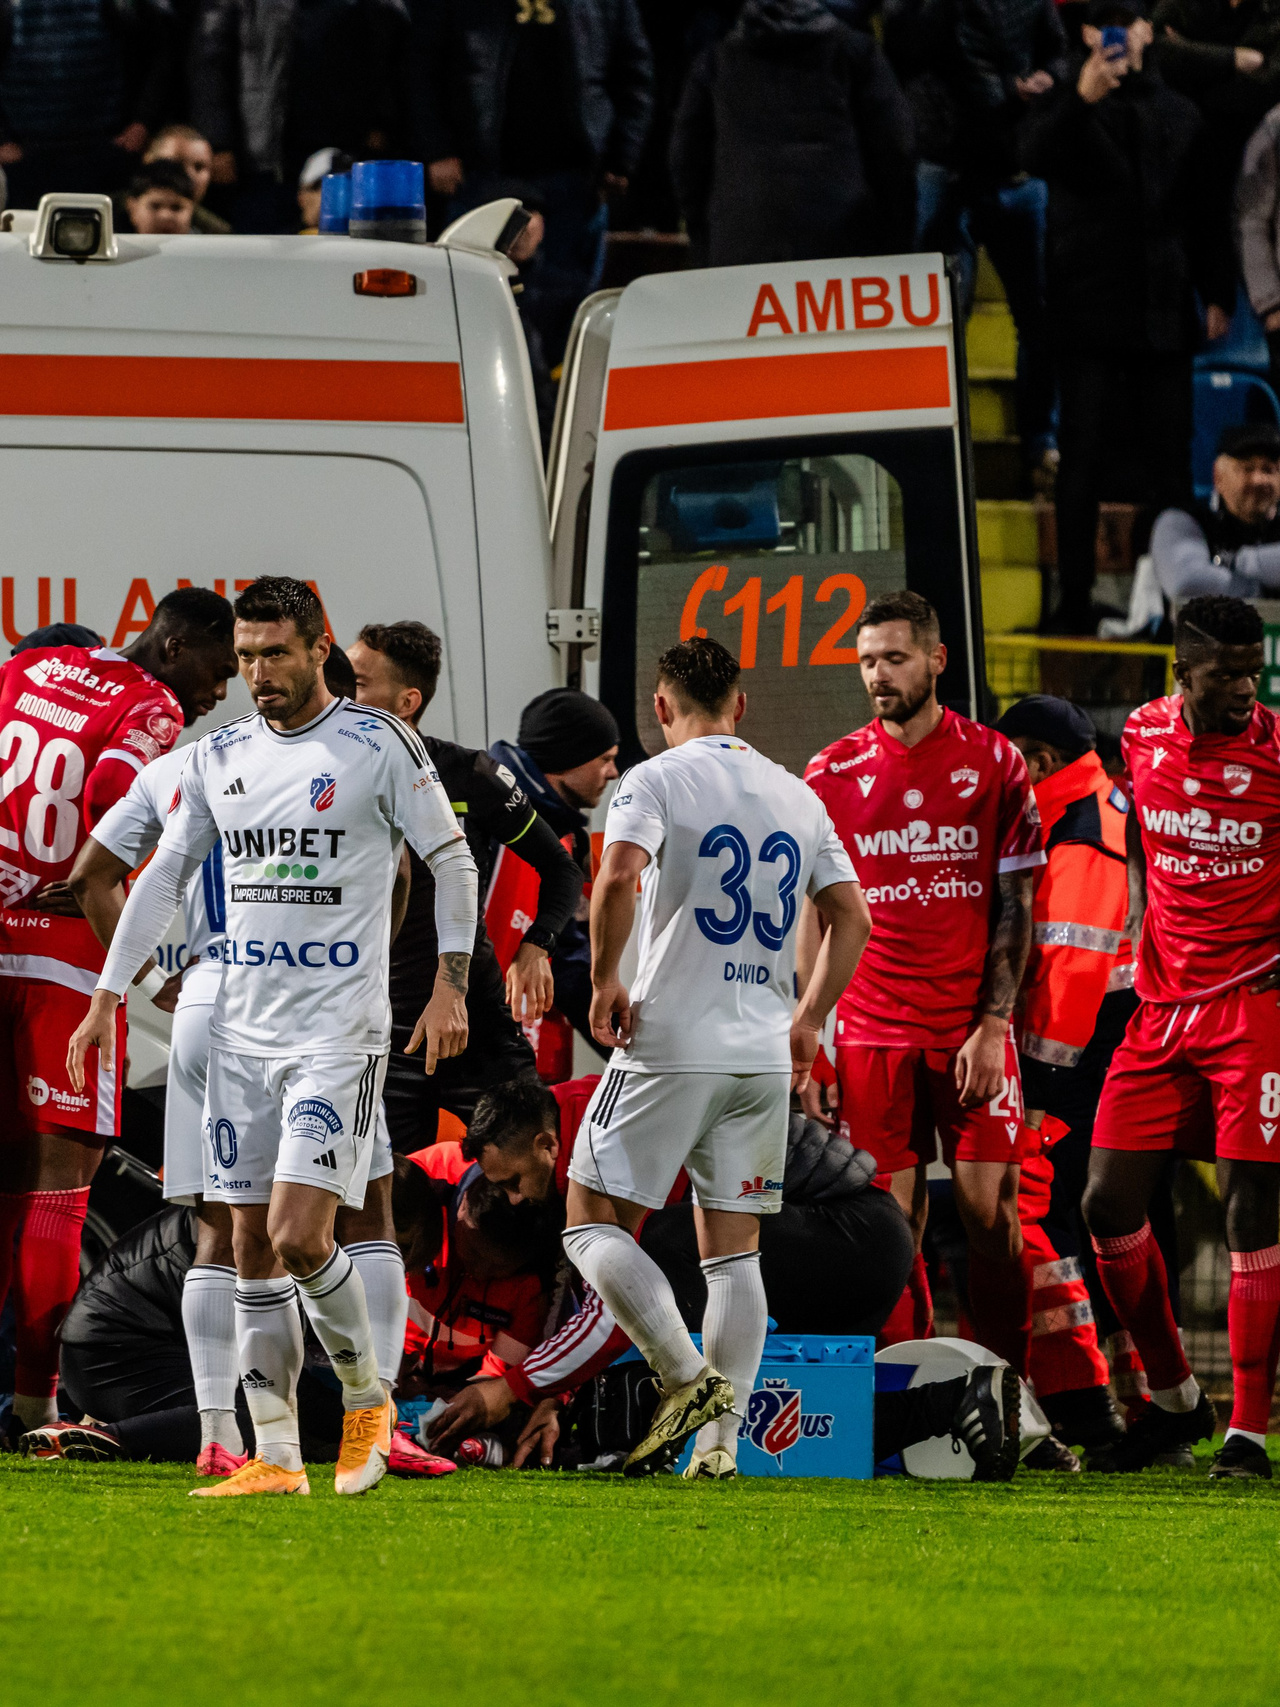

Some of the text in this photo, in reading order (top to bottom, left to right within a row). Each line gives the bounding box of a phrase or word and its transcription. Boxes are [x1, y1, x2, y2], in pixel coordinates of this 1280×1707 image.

[747, 273, 940, 337] AMBU
[723, 572, 867, 669] 112
[44, 656, 125, 696] Regata.ro
[853, 820, 979, 858] WIN2.RO
[1142, 805, 1263, 846] WIN2.RO
[224, 828, 346, 859] UNIBET
[909, 853, 941, 863] CASINO
[281, 888, 311, 903] SPRE
[314, 889, 334, 904] 0%
[694, 824, 802, 952] 33
[223, 939, 360, 968] ELSACO
[723, 961, 770, 986] DAVID
[56, 1104, 81, 1112] GROUP
